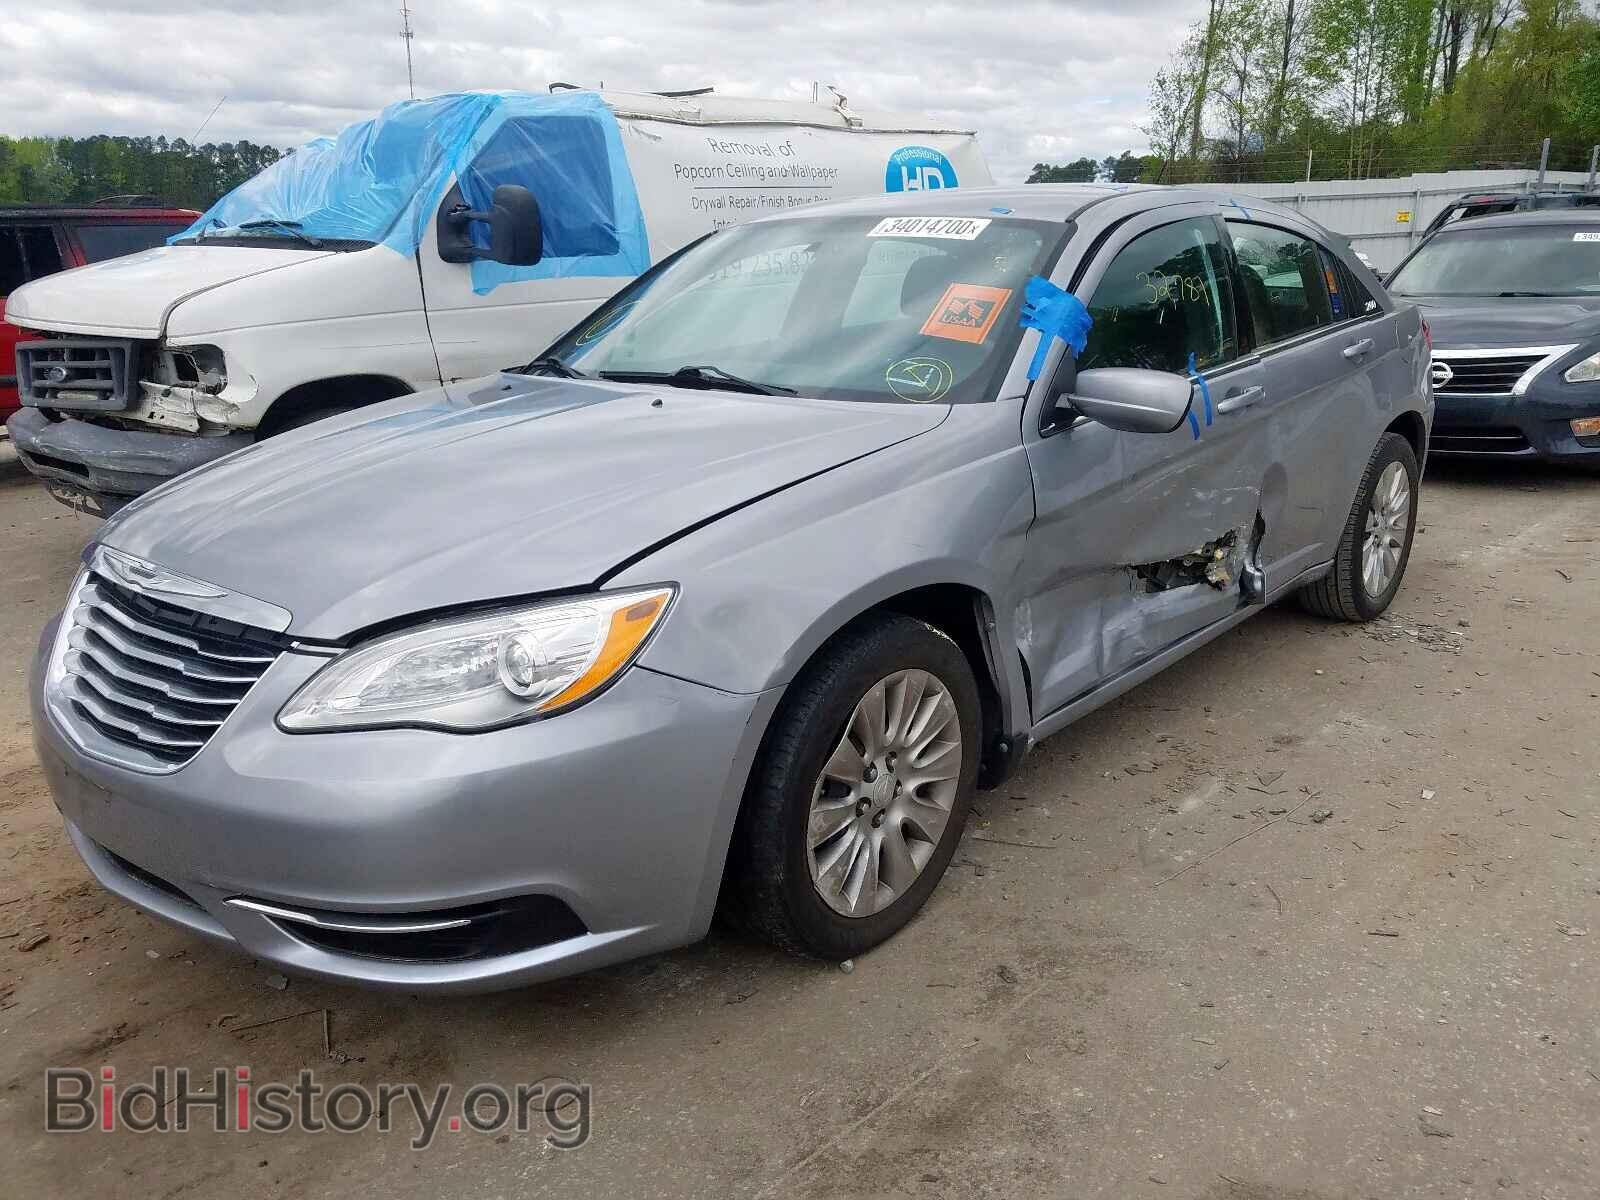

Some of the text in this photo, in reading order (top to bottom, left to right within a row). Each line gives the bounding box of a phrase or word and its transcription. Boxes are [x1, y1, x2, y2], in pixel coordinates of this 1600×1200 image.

[706, 137, 796, 157] Removal of
[674, 163, 725, 181] Popcorn
[726, 163, 765, 181] Ceiling
[691, 196, 726, 212] Drywall
